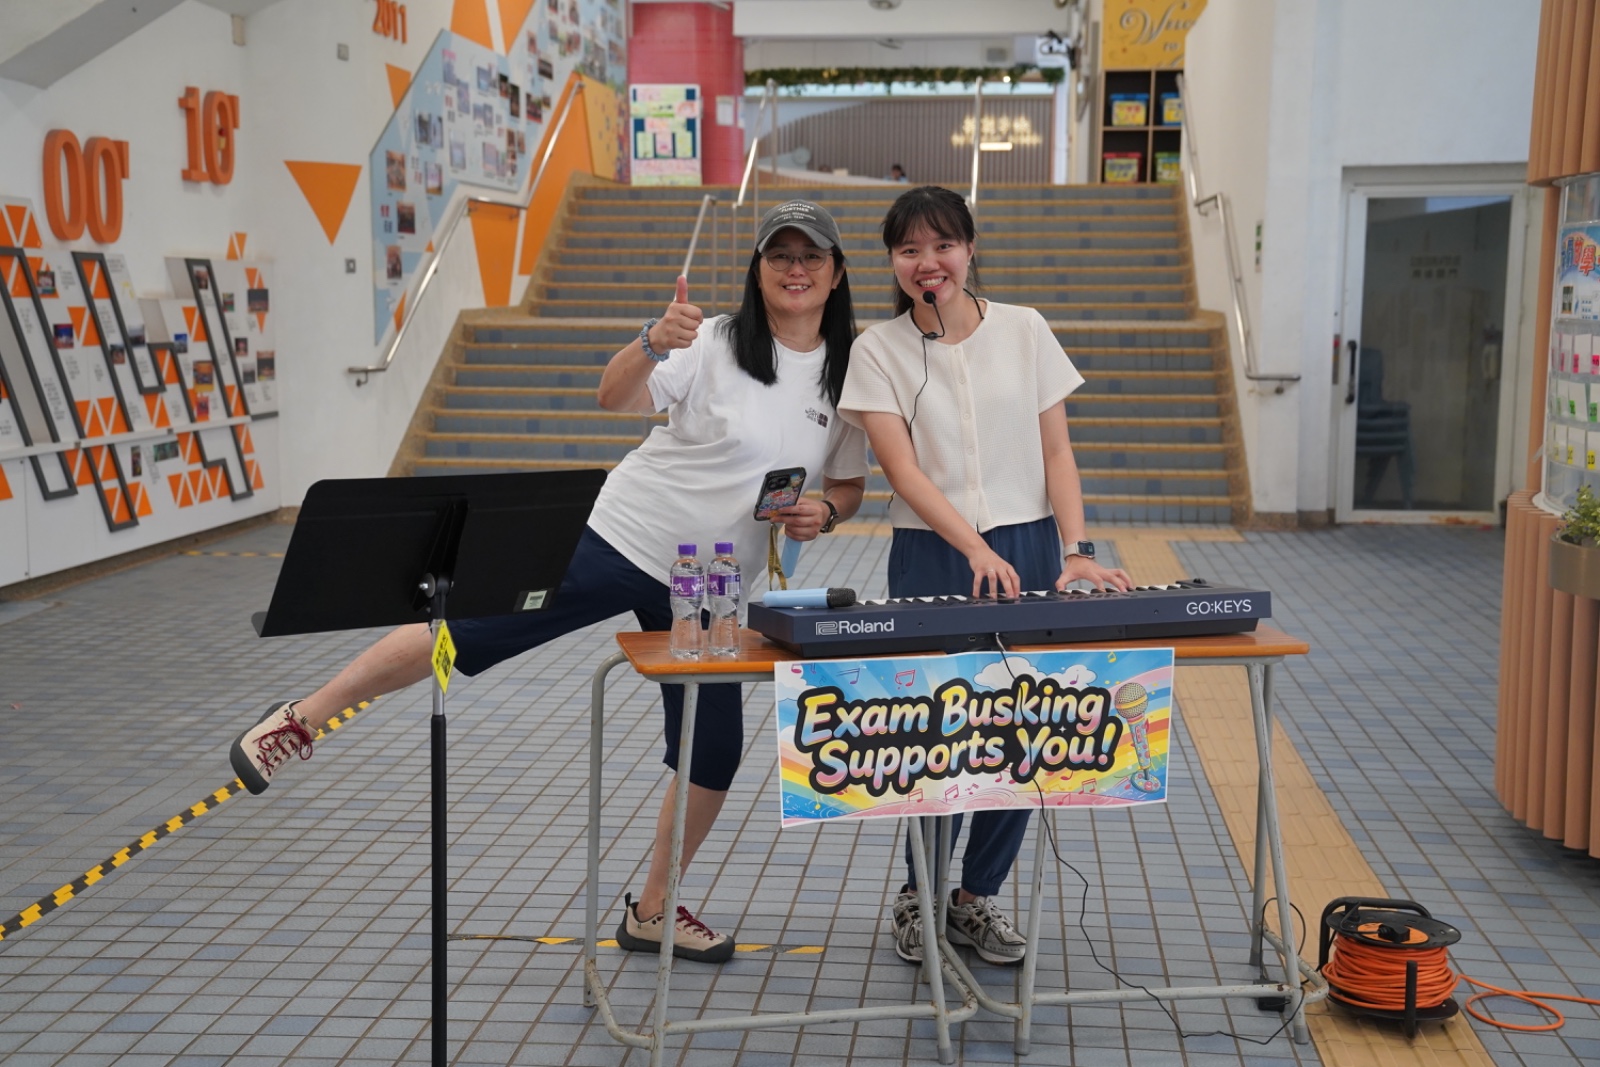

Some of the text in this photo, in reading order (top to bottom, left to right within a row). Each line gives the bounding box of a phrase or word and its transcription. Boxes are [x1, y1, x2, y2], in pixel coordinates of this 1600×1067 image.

[838, 618, 895, 635] Roland
[1186, 599, 1252, 615] GO:KEYS
[800, 681, 1105, 747] Exam Busking
[815, 722, 1117, 790] Supports You!
